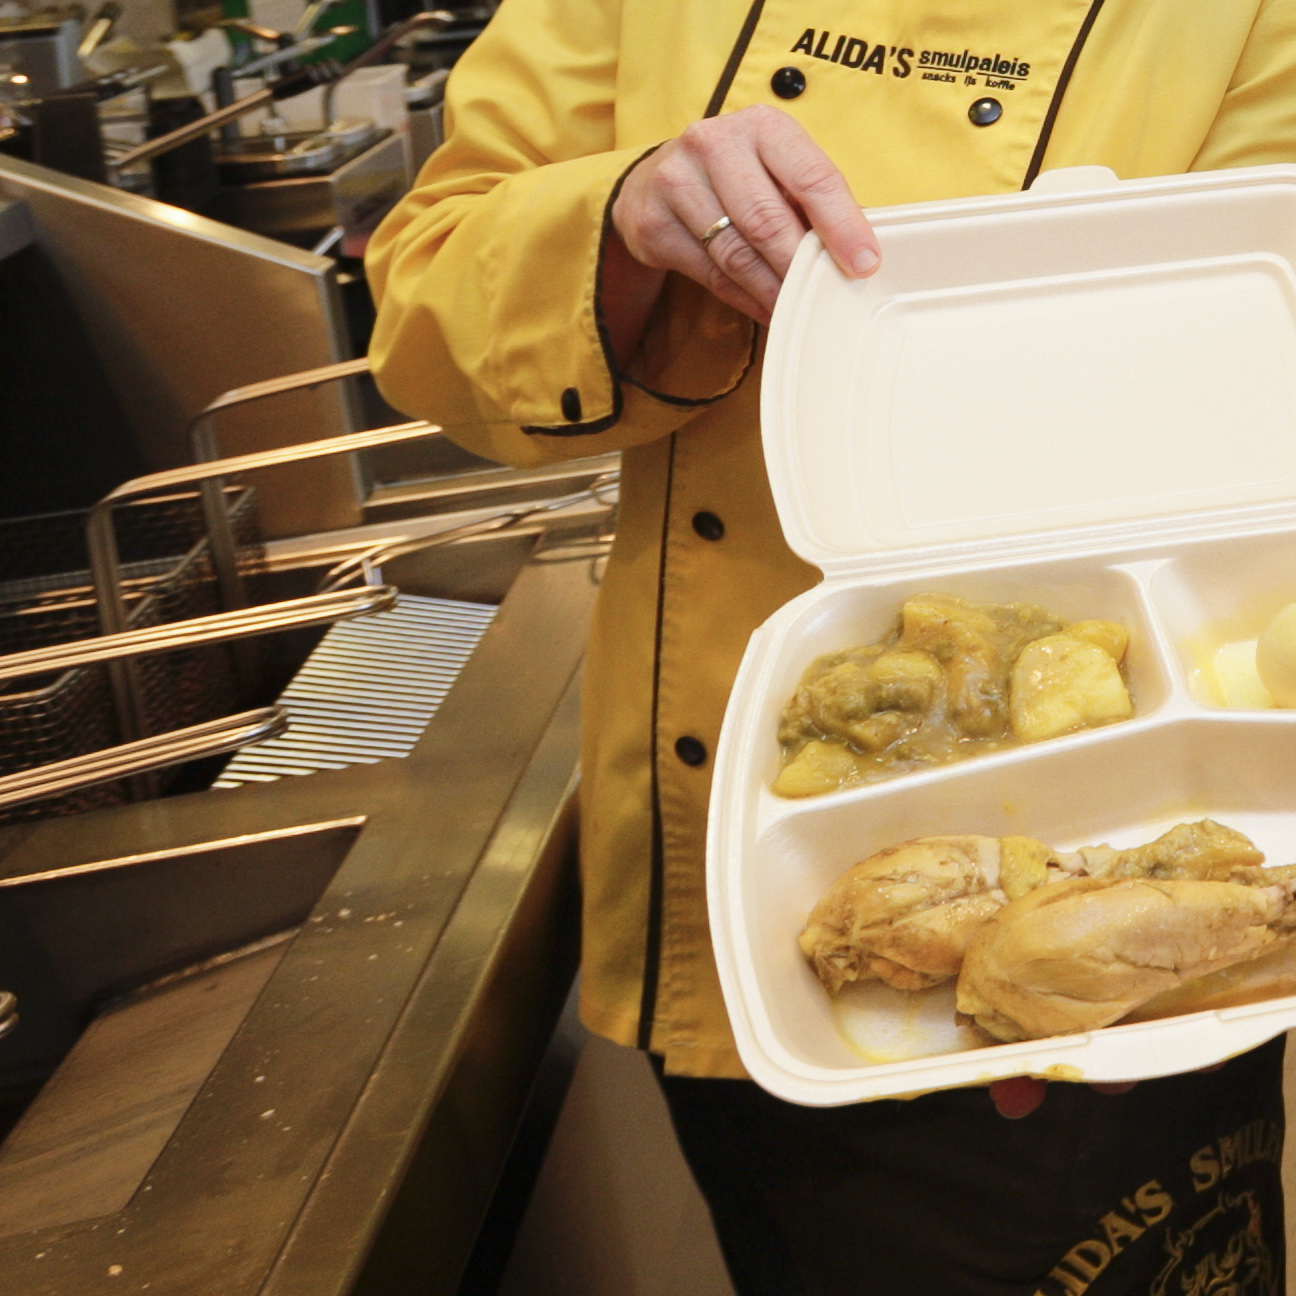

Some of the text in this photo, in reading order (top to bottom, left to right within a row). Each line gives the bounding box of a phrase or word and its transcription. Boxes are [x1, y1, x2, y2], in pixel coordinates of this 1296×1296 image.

[790, 28, 1031, 78] ALIDA'S smulpaleis
[921, 72, 956, 84] snacks
